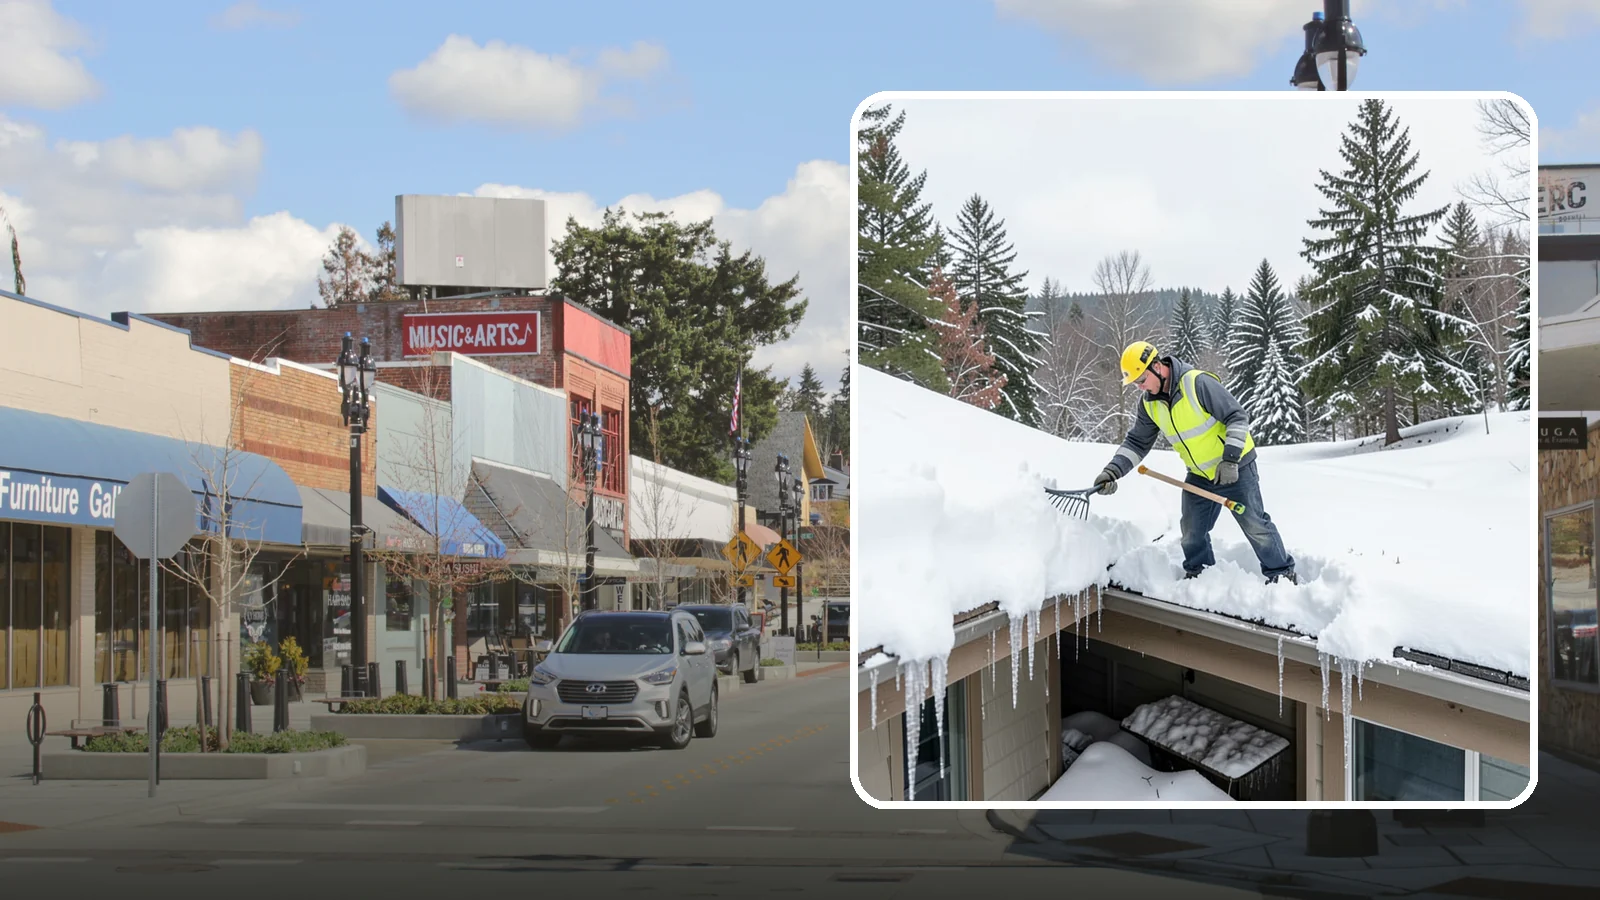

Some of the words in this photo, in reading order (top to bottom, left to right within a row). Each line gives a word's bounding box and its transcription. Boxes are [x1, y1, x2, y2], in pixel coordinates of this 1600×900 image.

[409, 323, 519, 349] MUSIC&ARTS
[0, 471, 79, 515] Furniture
[89, 482, 122, 519] Gal
